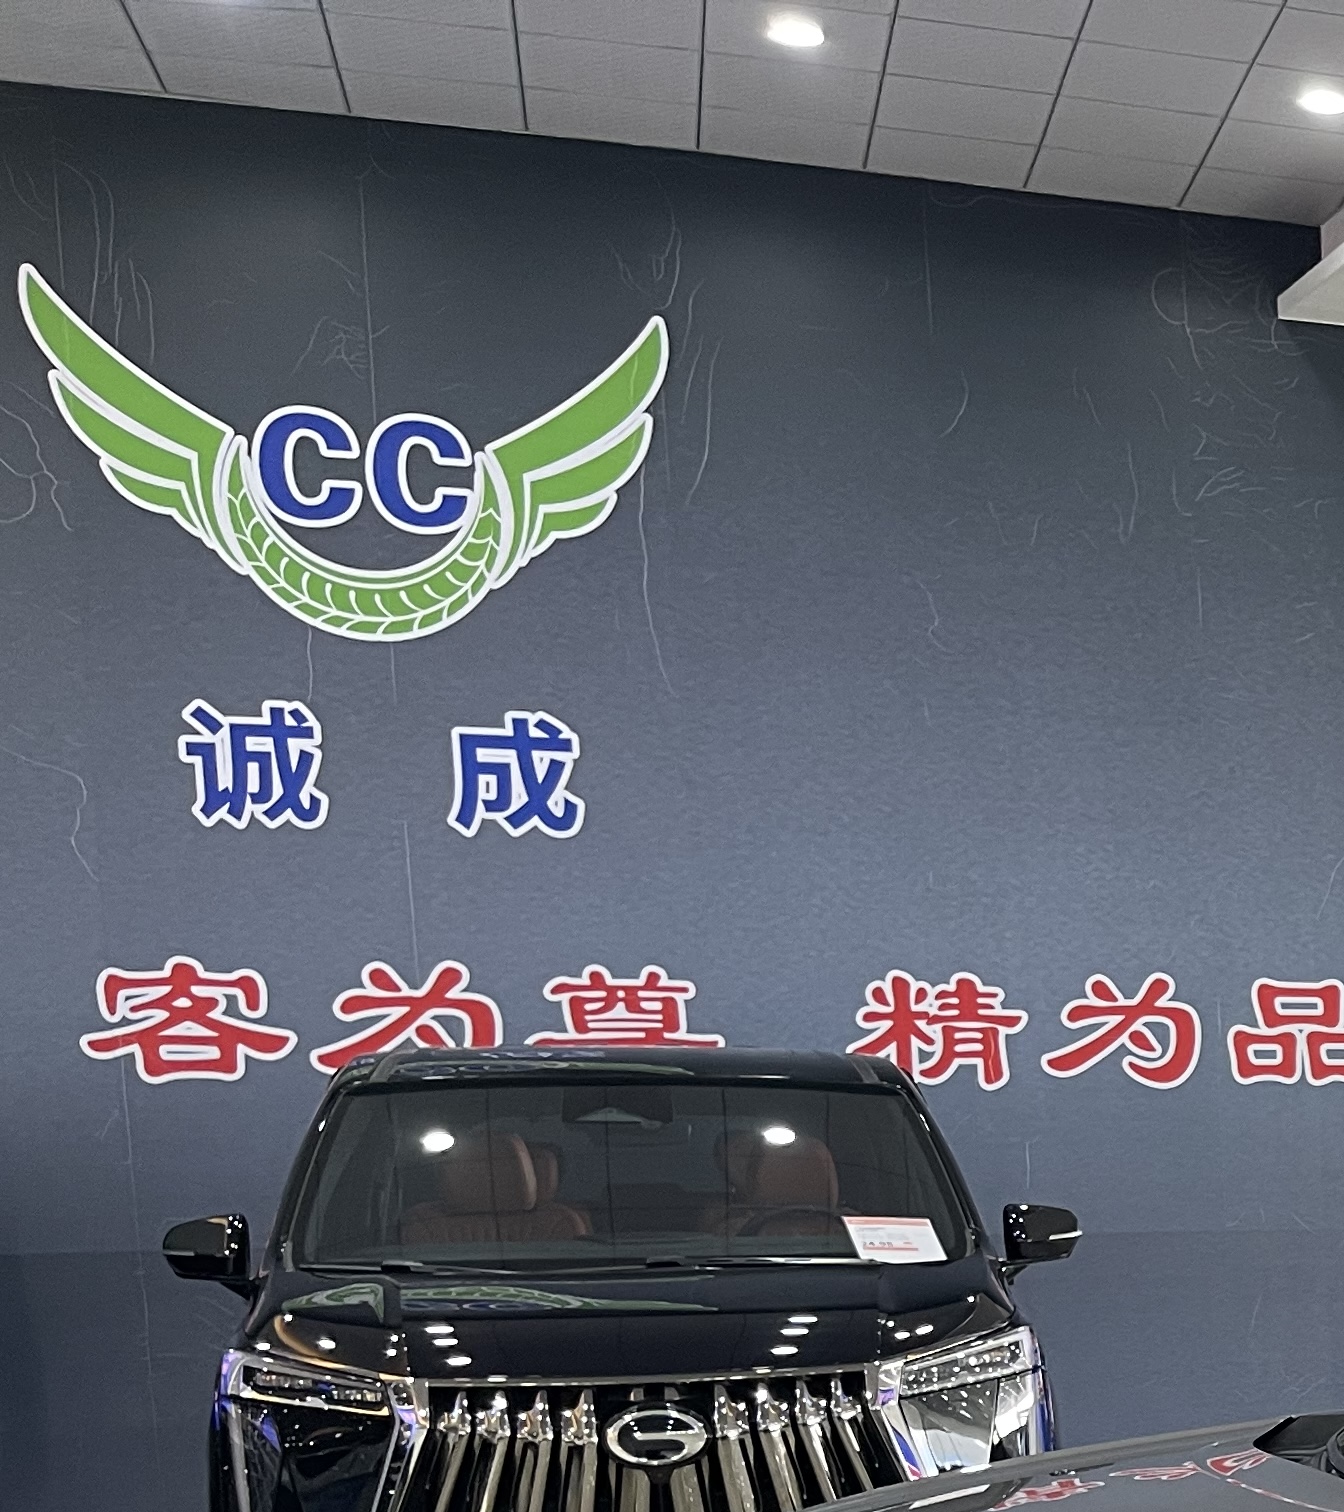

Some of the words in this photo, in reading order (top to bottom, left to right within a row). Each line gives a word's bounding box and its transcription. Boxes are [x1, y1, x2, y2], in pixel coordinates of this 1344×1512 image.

[251, 403, 477, 536] CC
[79, 954, 726, 1086] 客为尊
